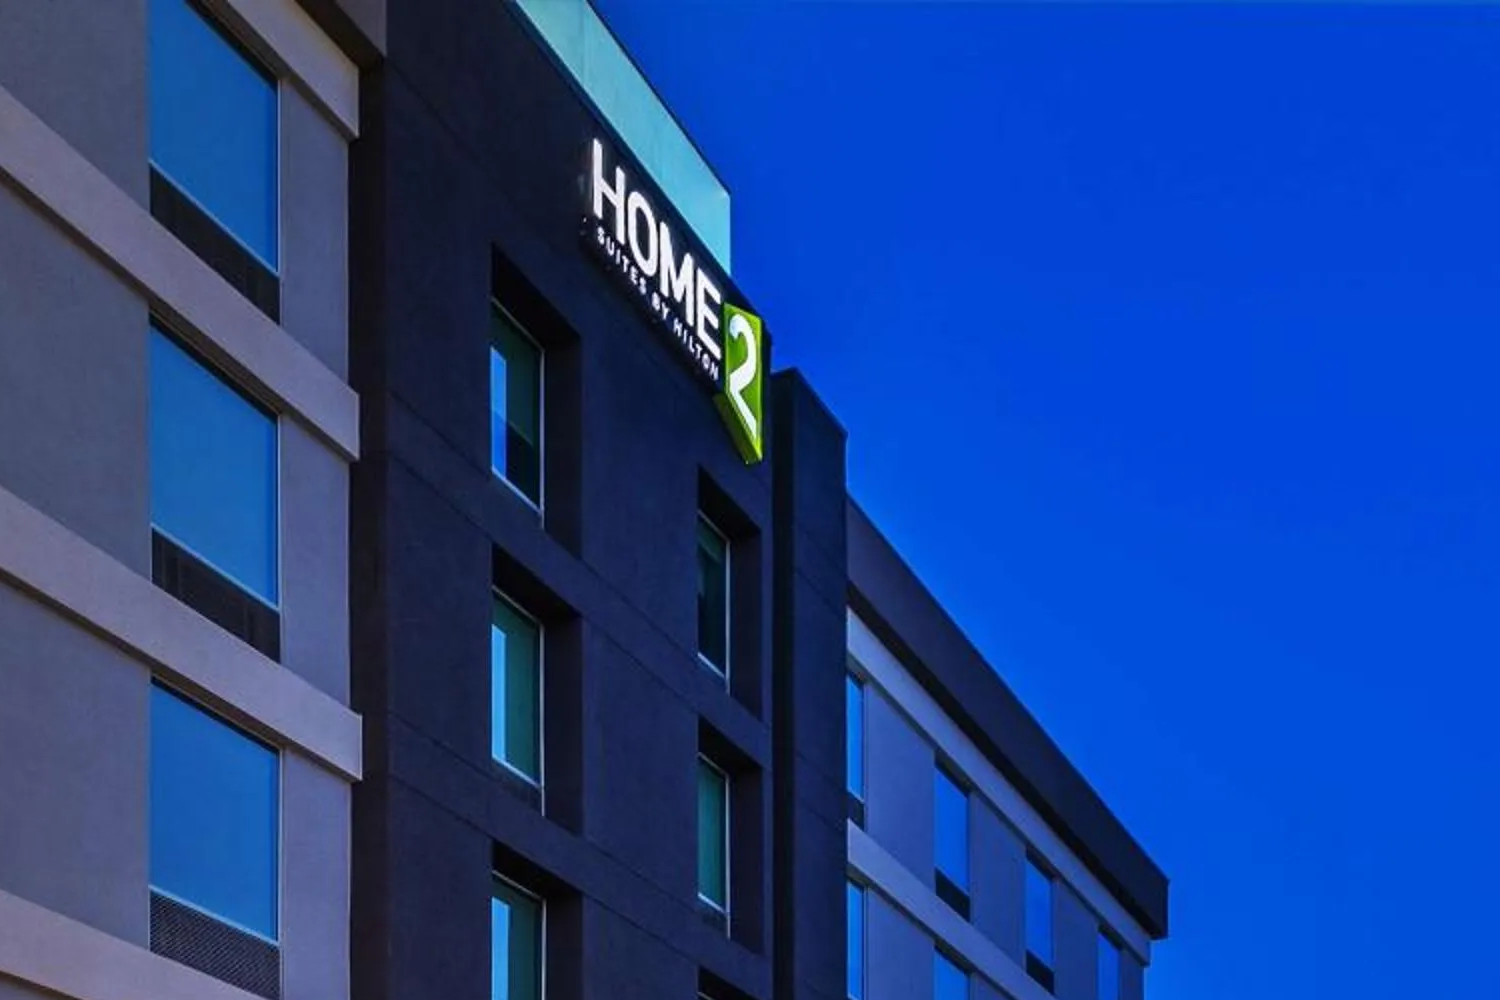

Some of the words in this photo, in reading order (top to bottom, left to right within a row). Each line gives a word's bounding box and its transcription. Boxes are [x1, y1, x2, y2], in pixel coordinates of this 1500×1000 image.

[593, 137, 721, 360] HOME
[729, 313, 757, 440] 2
[597, 226, 647, 295] SUITES
[652, 291, 670, 320] BY
[673, 317, 719, 381] HILTON
